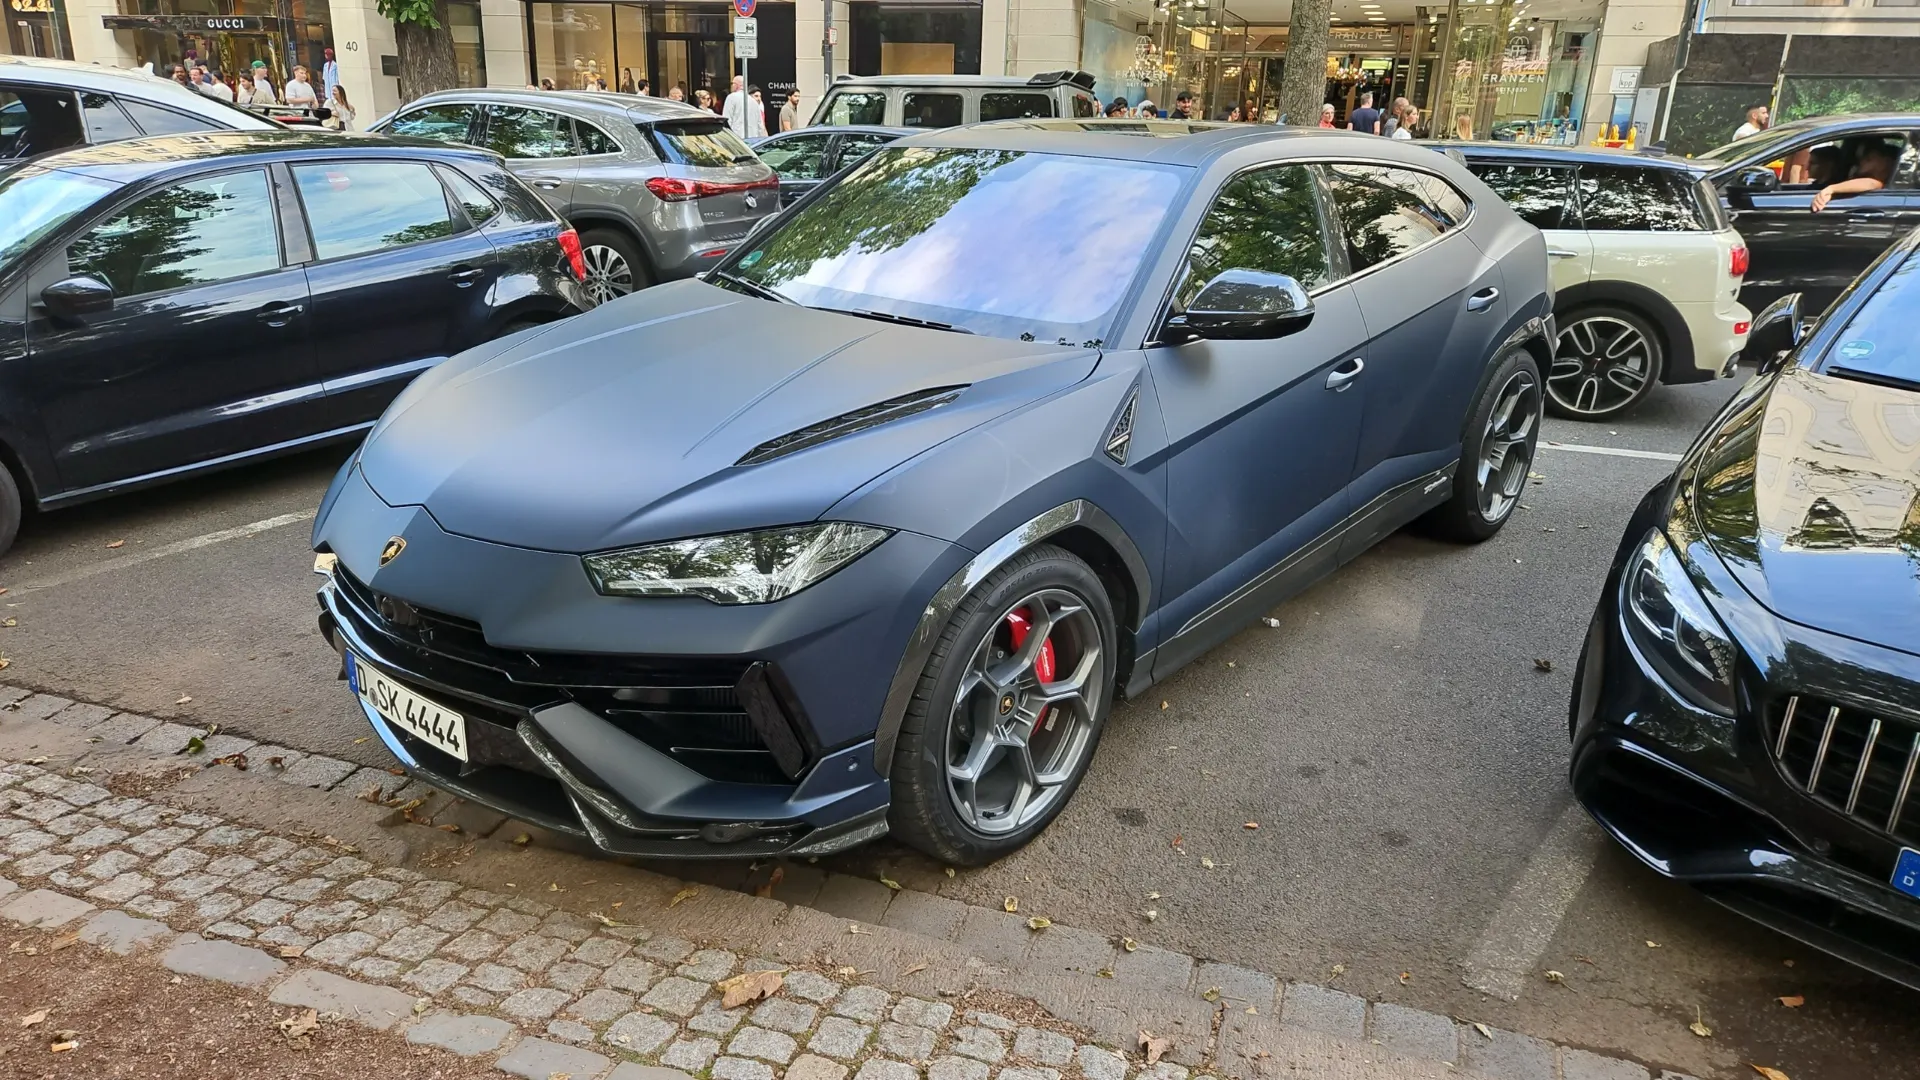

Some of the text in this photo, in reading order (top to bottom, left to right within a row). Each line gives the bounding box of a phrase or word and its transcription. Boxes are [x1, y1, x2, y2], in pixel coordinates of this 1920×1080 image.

[207, 18, 244, 29] GUCCI
[1328, 31, 1383, 40] FRANZEN
[345, 41, 358, 52] 40
[1115, 70, 1168, 79] FRANZEN
[1481, 73, 1545, 83] FRANZEN
[768, 81, 796, 90] CHANE
[356, 664, 460, 753] D SK 4444
[1903, 875, 1915, 887] D
